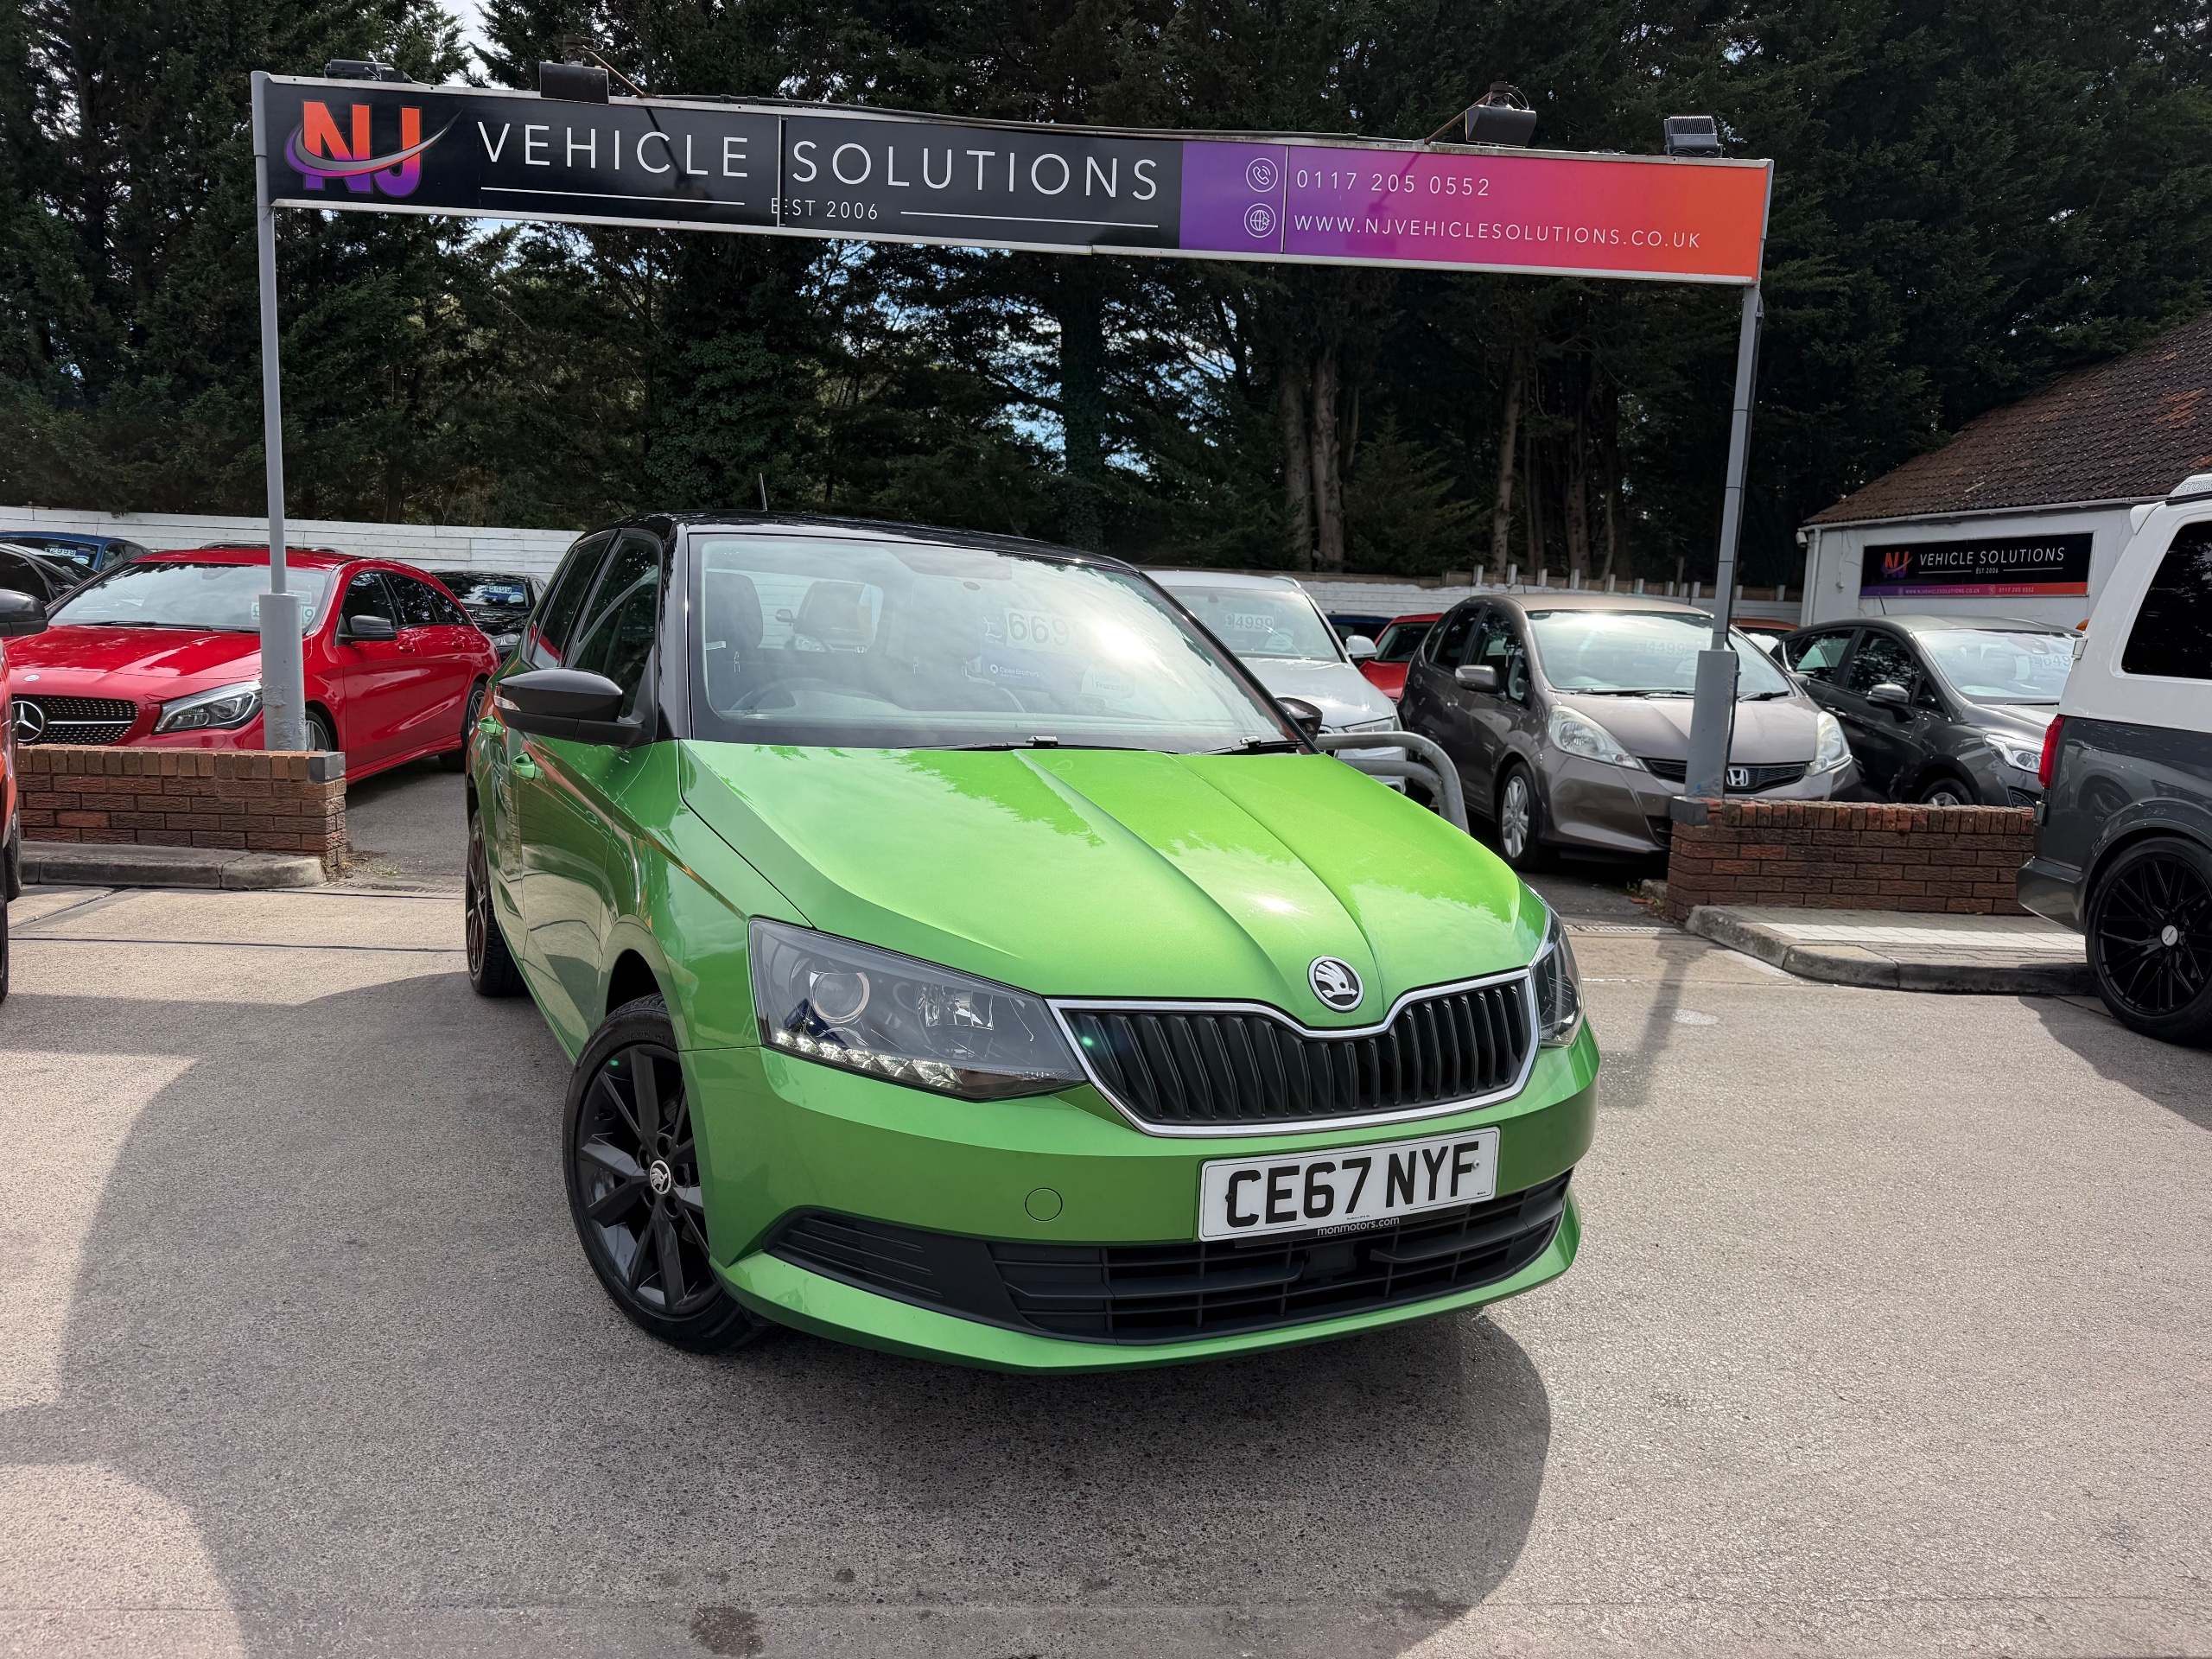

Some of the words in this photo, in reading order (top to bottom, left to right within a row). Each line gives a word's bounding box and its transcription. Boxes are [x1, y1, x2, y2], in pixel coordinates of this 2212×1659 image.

[302, 100, 422, 197] NJ
[477, 121, 749, 178] VEHICLE
[791, 140, 1158, 201] SOLUTIONS
[1296, 169, 1356, 190] 0117
[1370, 173, 1415, 194] 205
[1429, 175, 1491, 197] 0552
[771, 197, 816, 216] EST
[826, 200, 878, 220] 2006
[1294, 214, 1701, 249] WWW.NJVEHICLESOLUTIONS.CO.UK
[1883, 550, 1910, 578] NJ
[1920, 551, 1974, 566] VEHICLE
[1980, 547, 2066, 564] SOLUTIONS
[1986, 566, 1999, 575] 2006
[983, 612, 1071, 646] £669
[1000, 666, 1015, 675] Close
[1225, 1156, 1372, 1229] CE67
[1385, 1141, 1479, 1208] NYF
[1317, 1216, 1400, 1237] monmotors.com
